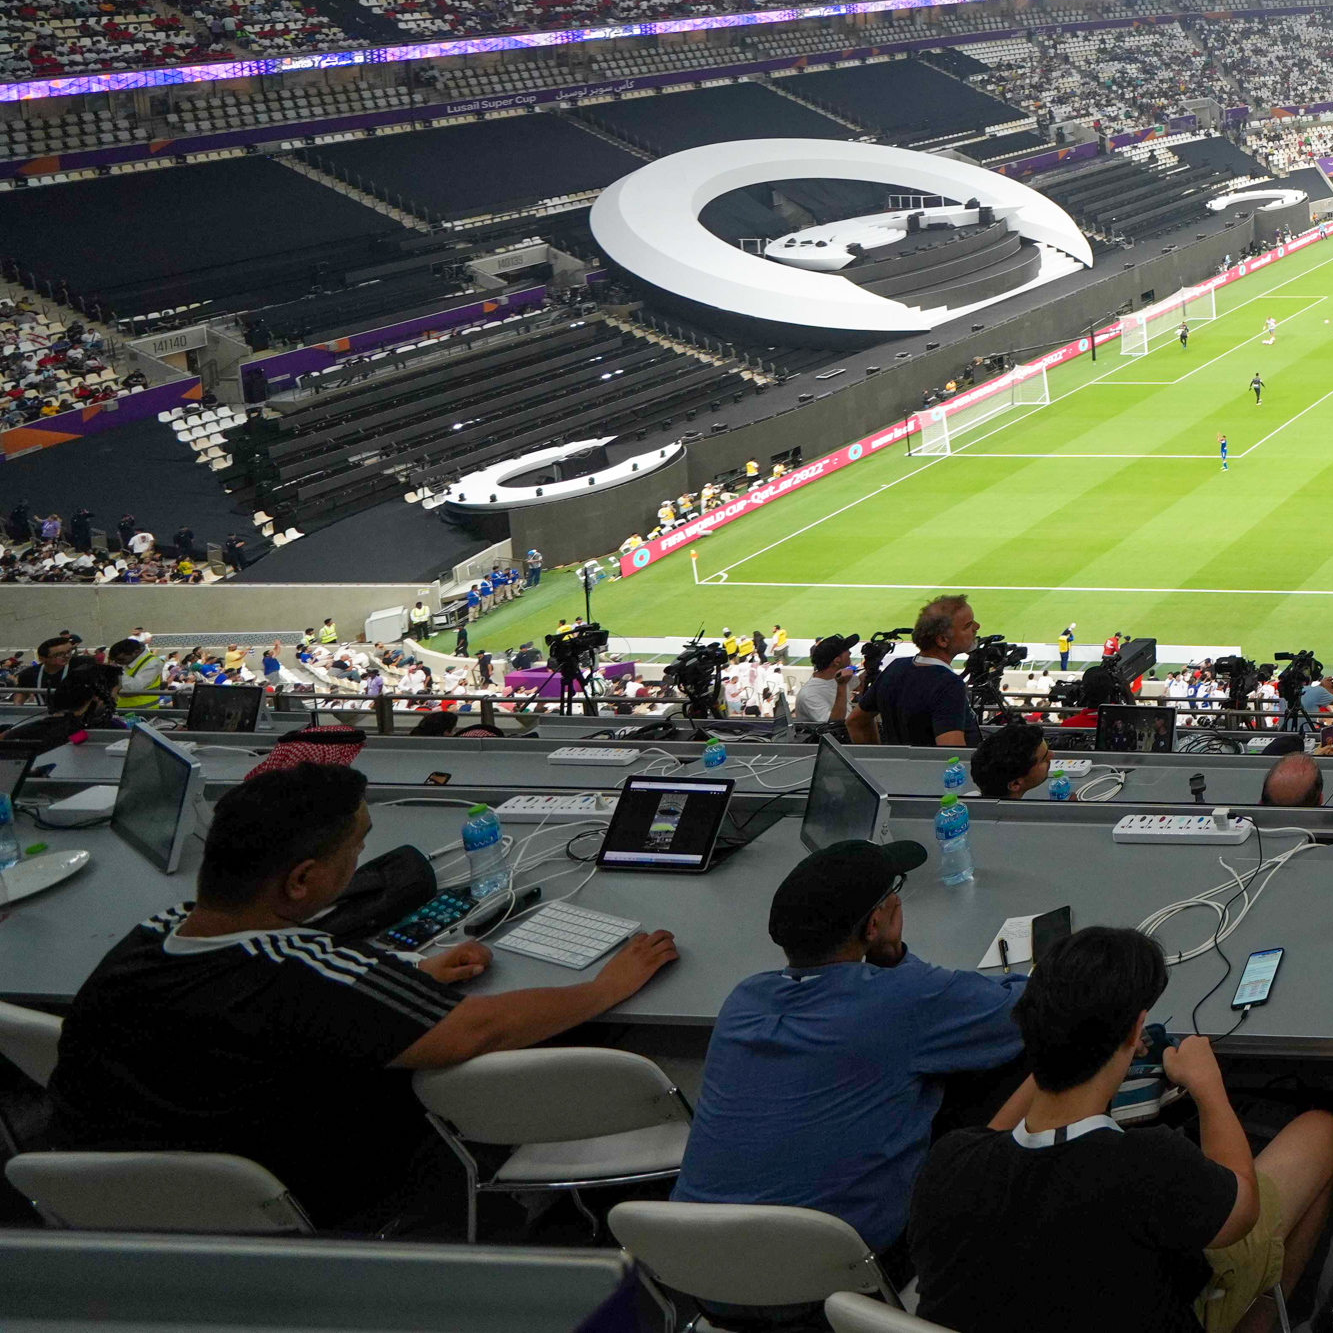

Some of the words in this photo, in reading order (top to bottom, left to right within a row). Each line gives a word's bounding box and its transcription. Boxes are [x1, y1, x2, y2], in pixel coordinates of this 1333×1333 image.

[447, 102, 480, 113] Lusail
[481, 98, 514, 108] Super
[515, 96, 537, 104] Cup
[153, 340, 167, 353] 141
[169, 335, 187, 350] 140
[661, 531, 686, 551] FIFA
[685, 511, 725, 537] WORLD
[725, 500, 748, 517] CUP
